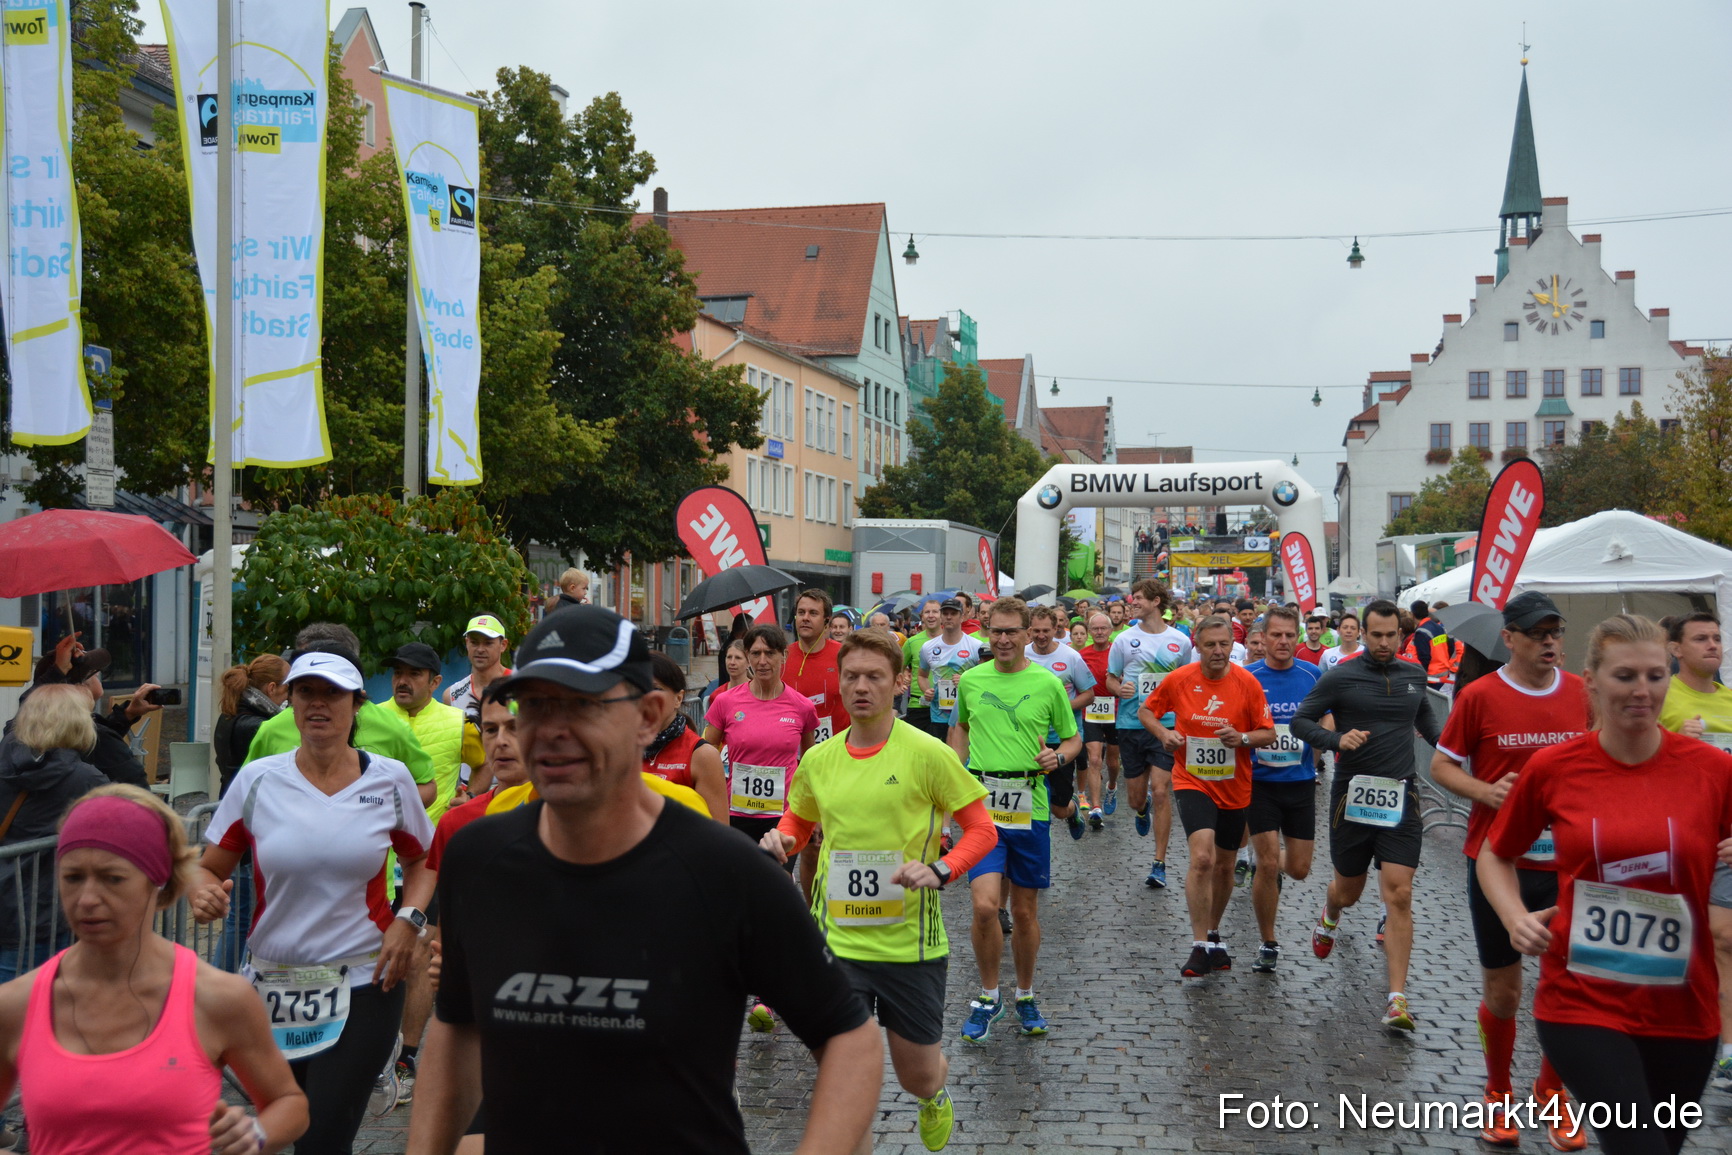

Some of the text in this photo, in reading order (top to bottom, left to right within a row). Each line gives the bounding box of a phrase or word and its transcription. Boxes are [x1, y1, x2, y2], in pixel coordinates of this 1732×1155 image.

[1070, 471, 1263, 496] BMW Laufsport
[1476, 480, 1535, 609] REWE
[1209, 555, 1233, 565] ZIEL
[1091, 702, 1110, 714] 249
[1267, 702, 1302, 713] YSCA
[1190, 713, 1229, 723] funrunners
[1195, 748, 1227, 765] 330
[1271, 753, 1287, 761] Marc
[1197, 766, 1225, 775] Manfred
[742, 776, 775, 798] 189
[359, 795, 385, 806] Melitta
[746, 799, 766, 809] Anita
[988, 790, 1022, 810] 147
[1352, 786, 1399, 809] 2653
[993, 812, 1013, 823] Horst
[1358, 808, 1388, 820] Thomas
[1621, 861, 1650, 875] DEHN
[847, 869, 880, 897] 83
[844, 903, 882, 916] Florian
[1584, 905, 1681, 953] 3078
[495, 972, 650, 1010] ARZT
[266, 987, 339, 1024] 2751
[493, 1006, 646, 1030] www.arzt-reisen.de
[285, 1031, 325, 1047] Melitta
